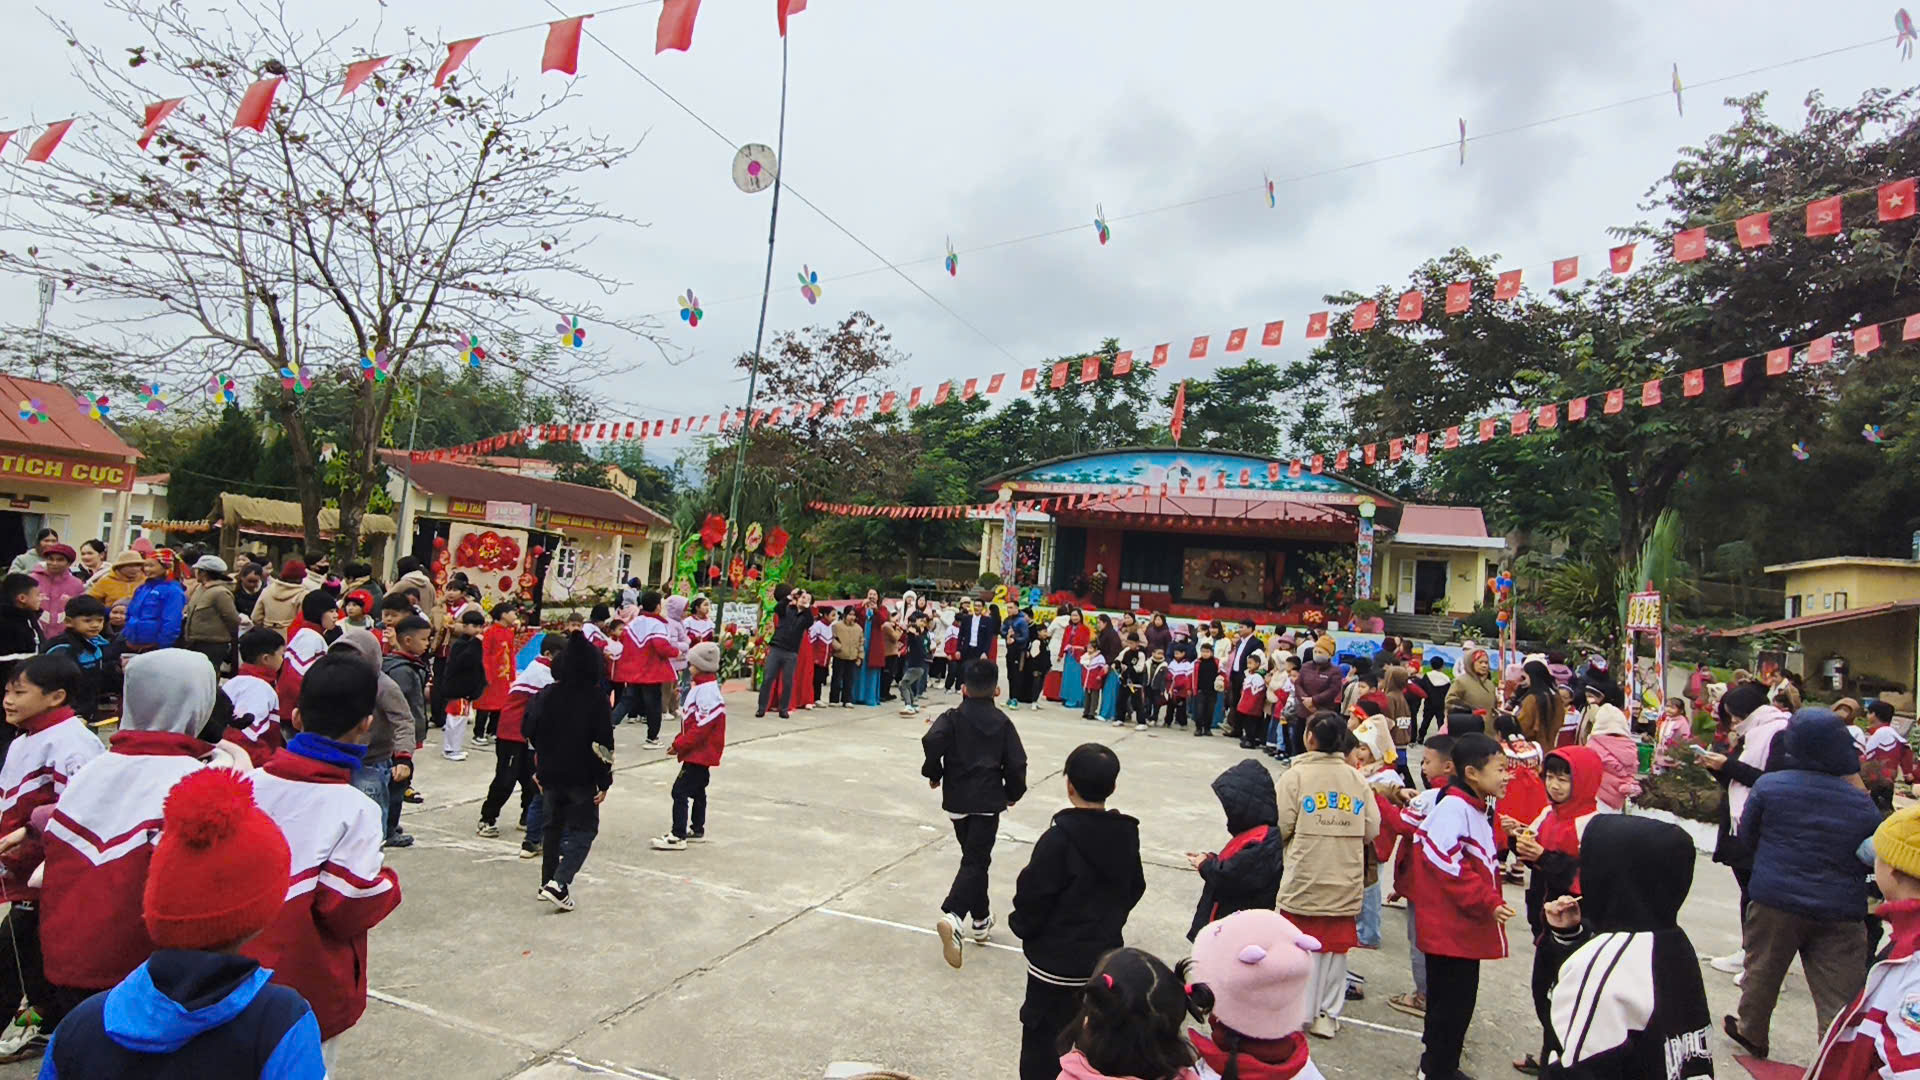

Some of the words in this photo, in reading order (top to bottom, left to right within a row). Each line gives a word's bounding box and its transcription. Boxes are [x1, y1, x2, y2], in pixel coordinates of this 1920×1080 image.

[1, 454, 63, 477] TÍCH
[71, 464, 124, 485] CỰC
[1303, 791, 1364, 815] OBERY
